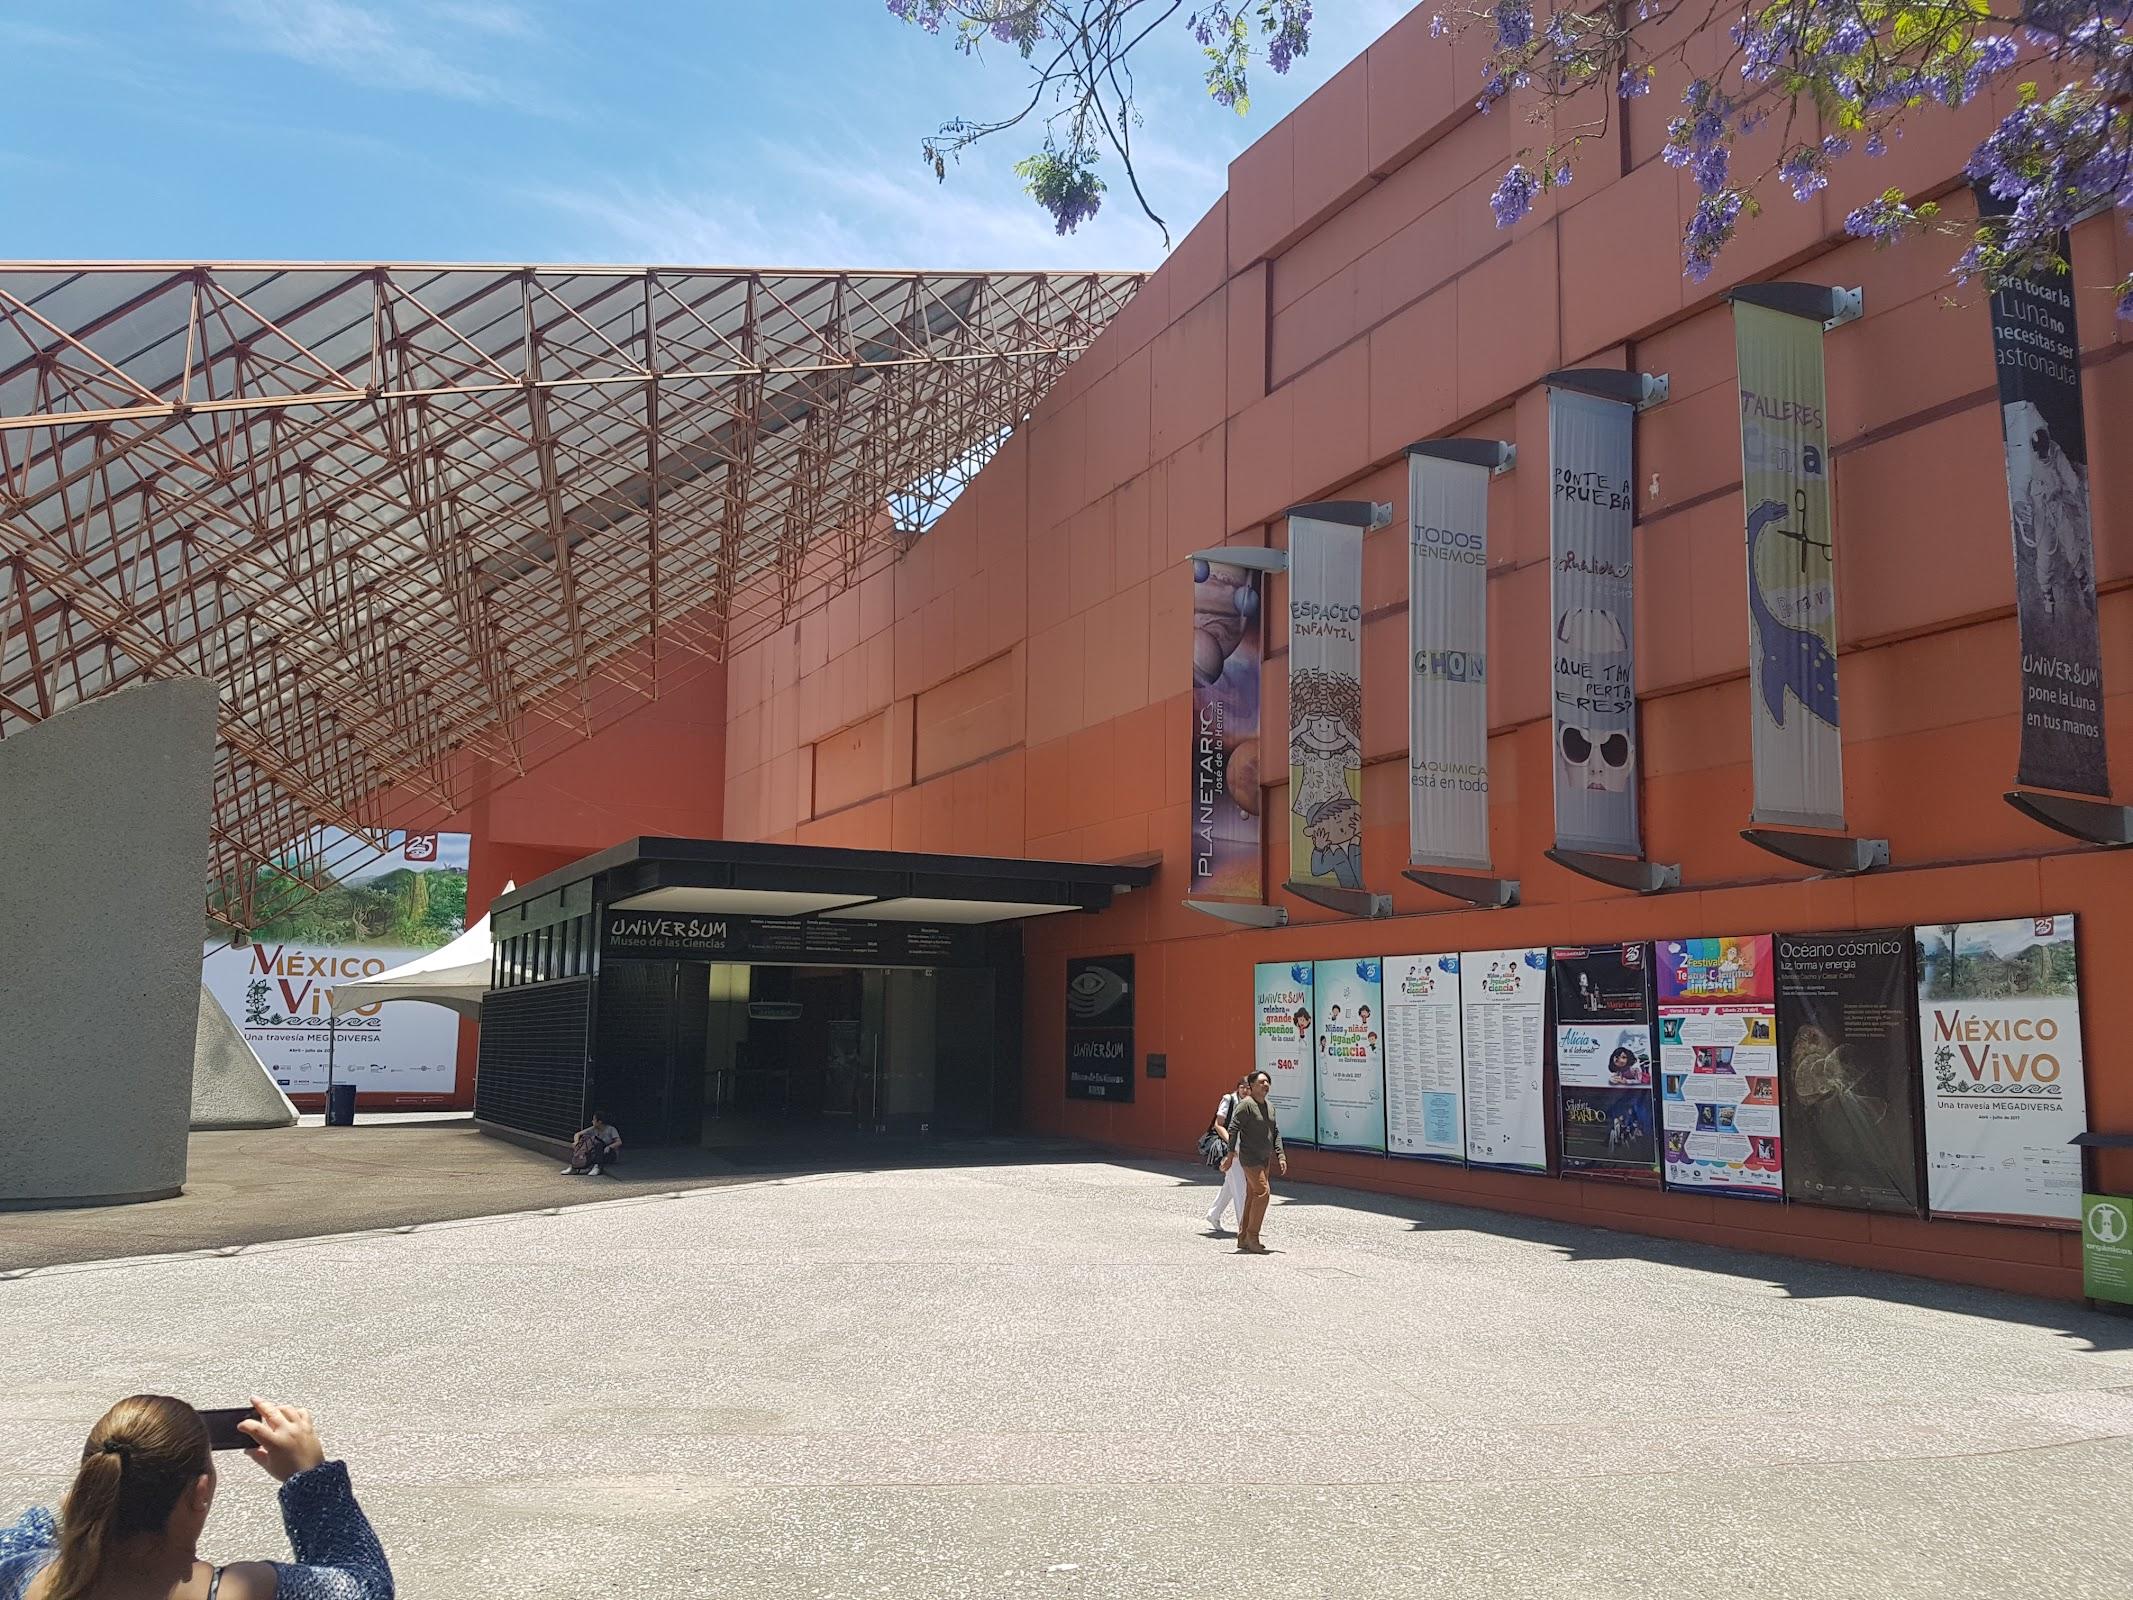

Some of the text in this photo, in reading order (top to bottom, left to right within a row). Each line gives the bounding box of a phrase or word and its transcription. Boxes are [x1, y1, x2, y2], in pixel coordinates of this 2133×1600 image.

[2025, 279, 2058, 302] tocar
[2059, 289, 2071, 308] la
[2000, 291, 2065, 334] Luna no
[1995, 326, 2074, 360] necesitas ser
[1997, 348, 2077, 385] astronauta
[1741, 389, 1823, 429] TALLERES
[1555, 468, 1629, 493] PONTE A
[1554, 484, 1631, 511] PRUEBA
[1414, 524, 1482, 550] TODOS
[1411, 542, 1487, 566] TENEMOS
[1290, 601, 1360, 623] ESPACIO
[1295, 622, 1355, 642] INFANTIL
[1603, 662, 1632, 683] TAN
[1555, 690, 1632, 714] ERES?
[2029, 686, 2096, 712] pone la Luna
[2027, 712, 2099, 738] en tus manos
[1214, 755, 1223, 767] de
[1214, 772, 1223, 795] José
[1411, 774, 1489, 793] está en todo
[406, 835, 435, 859] 25
[2035, 918, 2053, 935] 25
[610, 936, 726, 949] Museo de las Ciencias
[1625, 945, 1641, 961] 25
[1780, 939, 1902, 958] Océano cósmico
[250, 944, 385, 978] MÉXICO
[1688, 956, 1720, 967] Festival
[1794, 960, 1818, 970] forma
[1825, 959, 1856, 971] energía
[1266, 1013, 1291, 1025] grande
[1934, 1009, 2059, 1042] MÉXICO
[244, 1033, 263, 1042] Una
[266, 1033, 304, 1042] travesía
[1259, 1024, 1294, 1037] pequeños
[1330, 1032, 1361, 1045] jugando
[1559, 1027, 1590, 1047] Alicia
[1328, 1043, 1367, 1057] ciencia
[1937, 1101, 2064, 1112] Una travesía MEGADIVERSA
